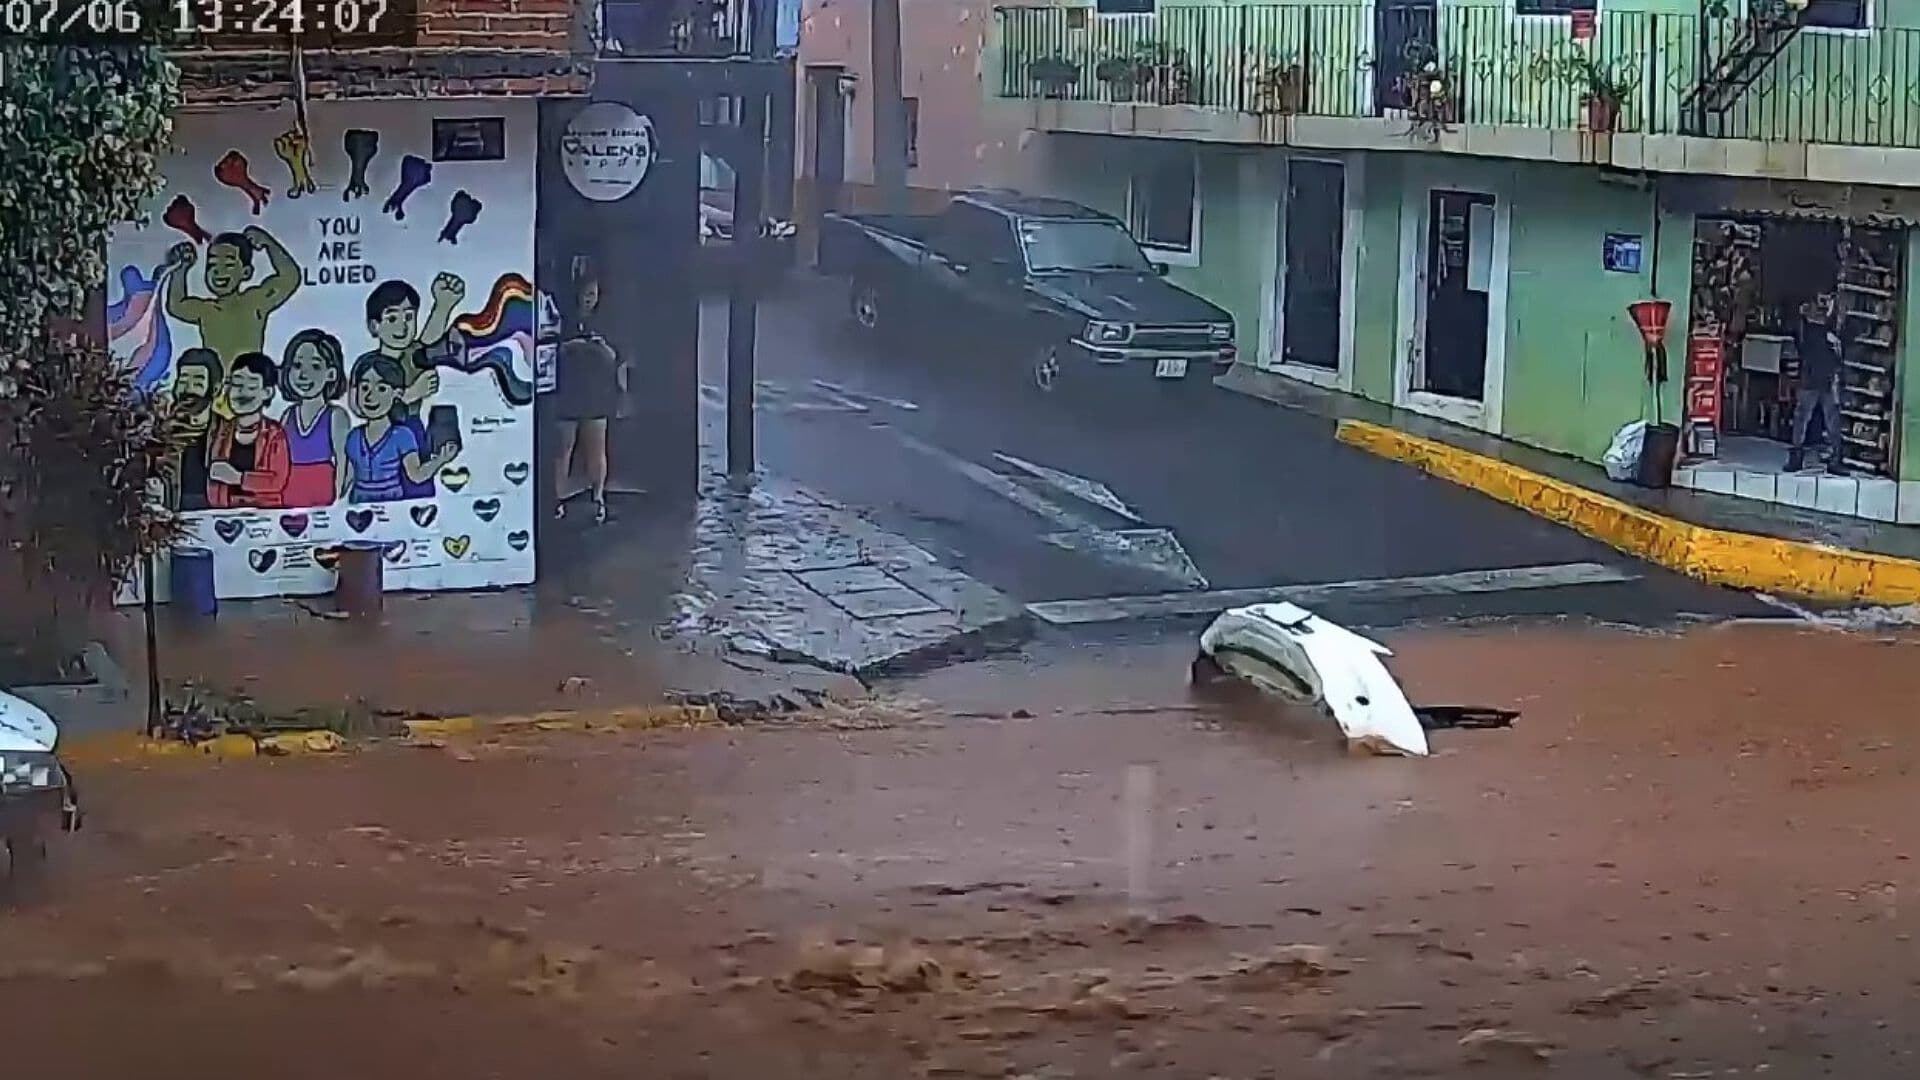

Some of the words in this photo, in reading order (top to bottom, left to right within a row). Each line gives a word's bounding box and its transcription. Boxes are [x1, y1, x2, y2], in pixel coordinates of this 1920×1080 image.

[318, 216, 361, 238] YOU
[318, 241, 362, 261] ARE
[304, 265, 377, 286] LOVED
